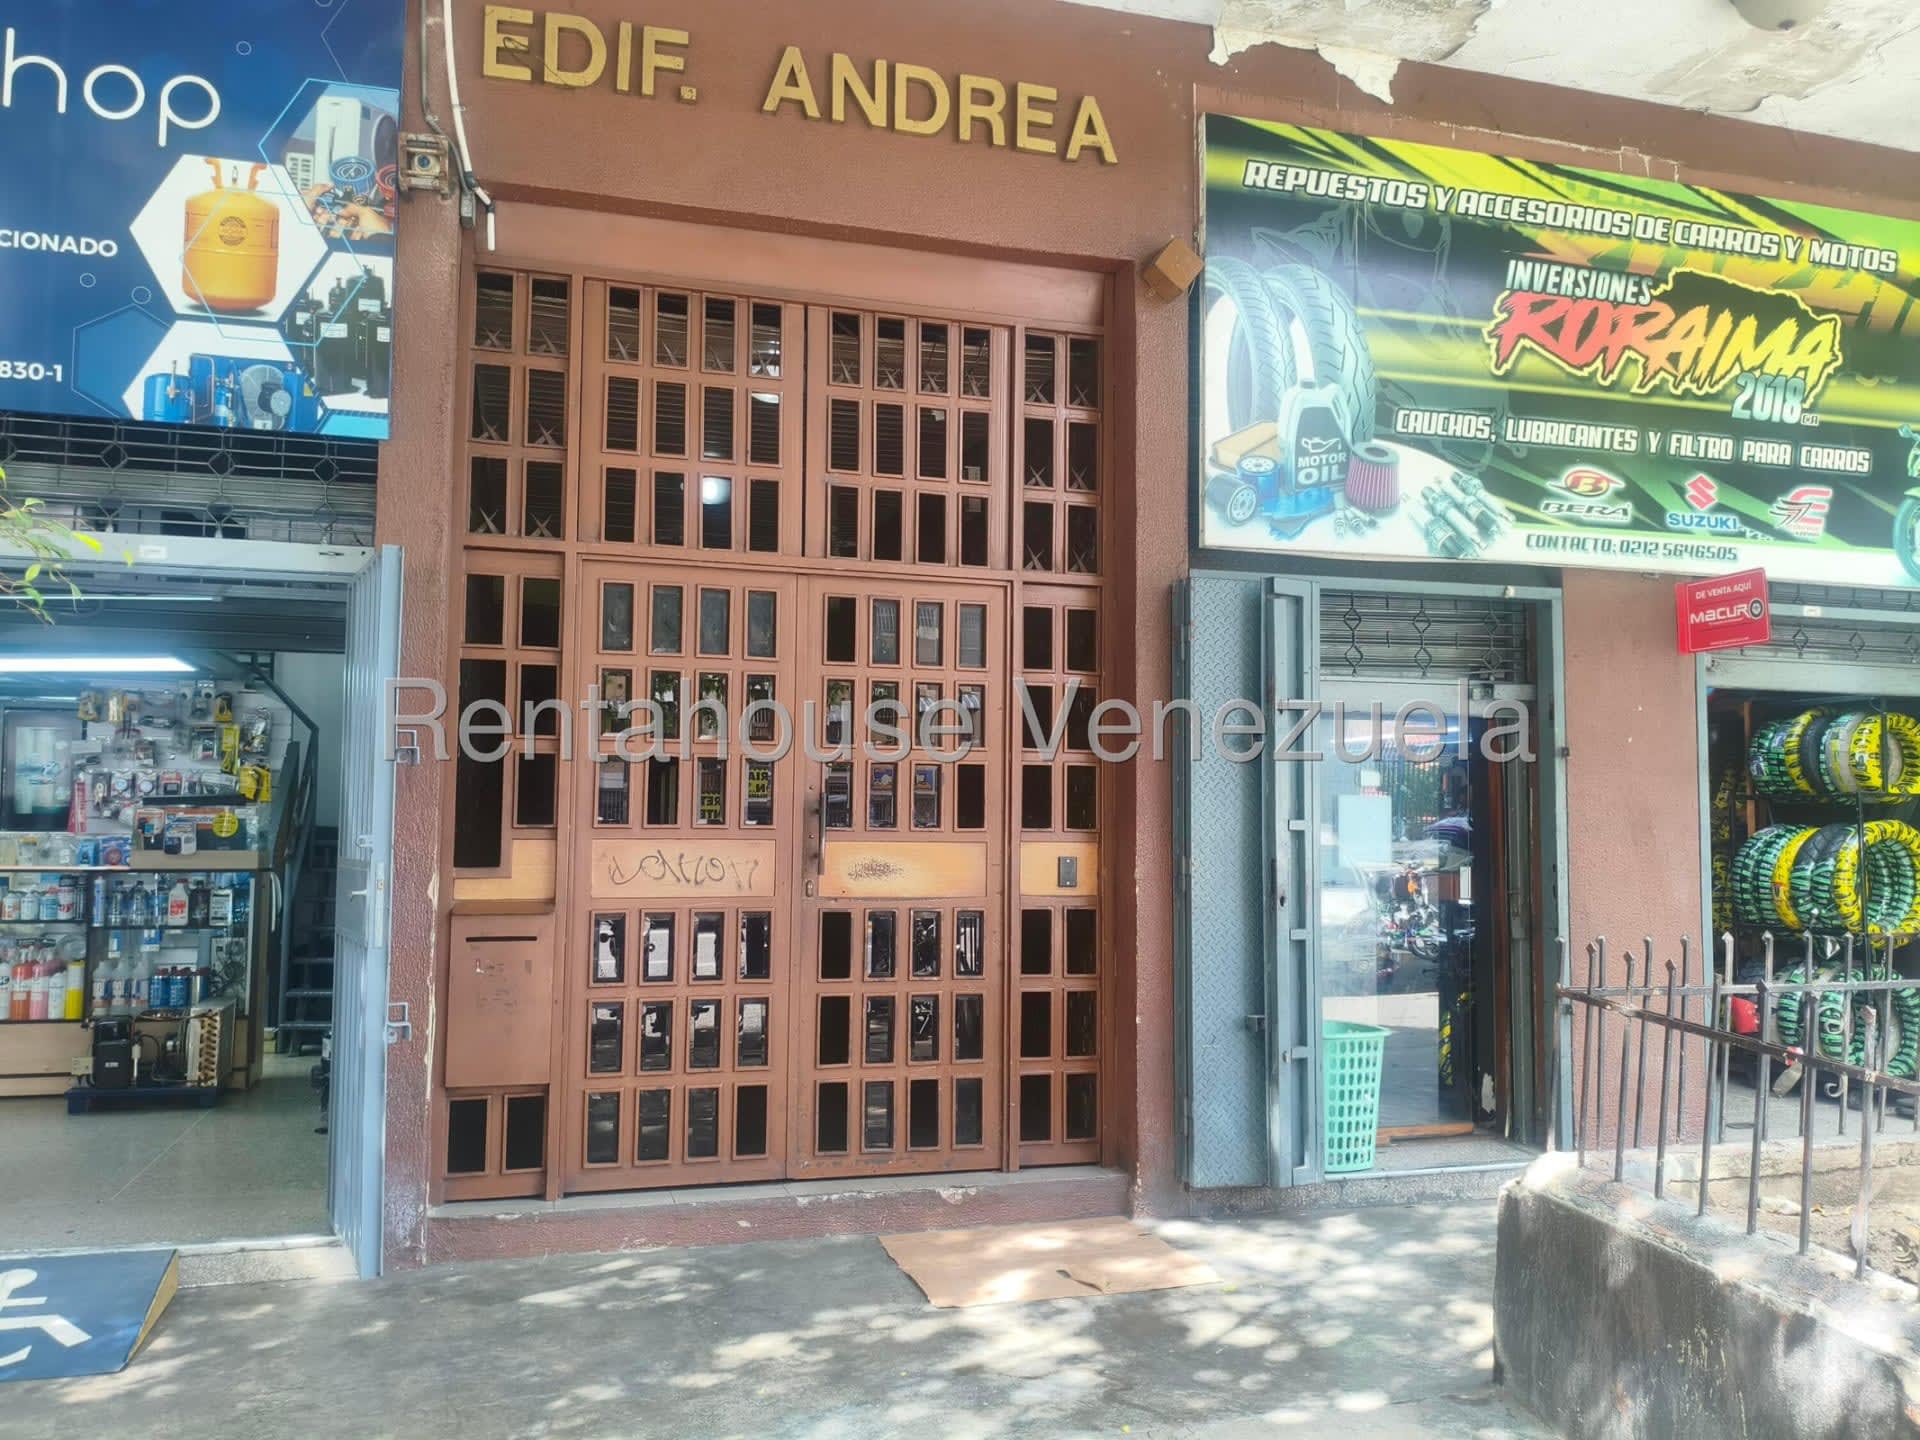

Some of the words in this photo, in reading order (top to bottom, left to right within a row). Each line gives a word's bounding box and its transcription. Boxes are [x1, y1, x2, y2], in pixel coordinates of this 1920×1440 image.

[3, 27, 220, 147] hop
[483, 4, 697, 102] EDIF.
[762, 46, 1118, 164] ANDREA
[1244, 161, 1427, 208] REPUESTOS
[1434, 188, 1454, 211] Y
[1457, 190, 1631, 236] ACCESORIOS
[1635, 216, 1669, 241] DE
[1675, 221, 1779, 257] CARROS
[1784, 236, 1802, 260] Y
[1809, 240, 1897, 272] MOTOS
[0, 229, 118, 257] CIONADO
[1506, 260, 1652, 304] INVERSIONES
[1492, 291, 1836, 396] RORAIMA
[0, 360, 63, 382] 830-1
[1732, 372, 1805, 424] 2018
[1396, 410, 1496, 442] CAUCHOS,
[1505, 418, 1638, 451] LUBRICANTES
[1648, 431, 1662, 453] Y
[1669, 433, 1734, 460] FILTRO
[1742, 439, 1792, 465] PARA
[1800, 446, 1870, 473] CARROS
[1298, 452, 1347, 468] MOTOR
[1298, 464, 1346, 484] OIL
[1542, 502, 1629, 517] BERA
[1668, 512, 1737, 530] SUZUKI
[1619, 539, 1659, 557] 0212
[1695, 590, 1706, 600] DE
[1707, 585, 1732, 597] VENTA
